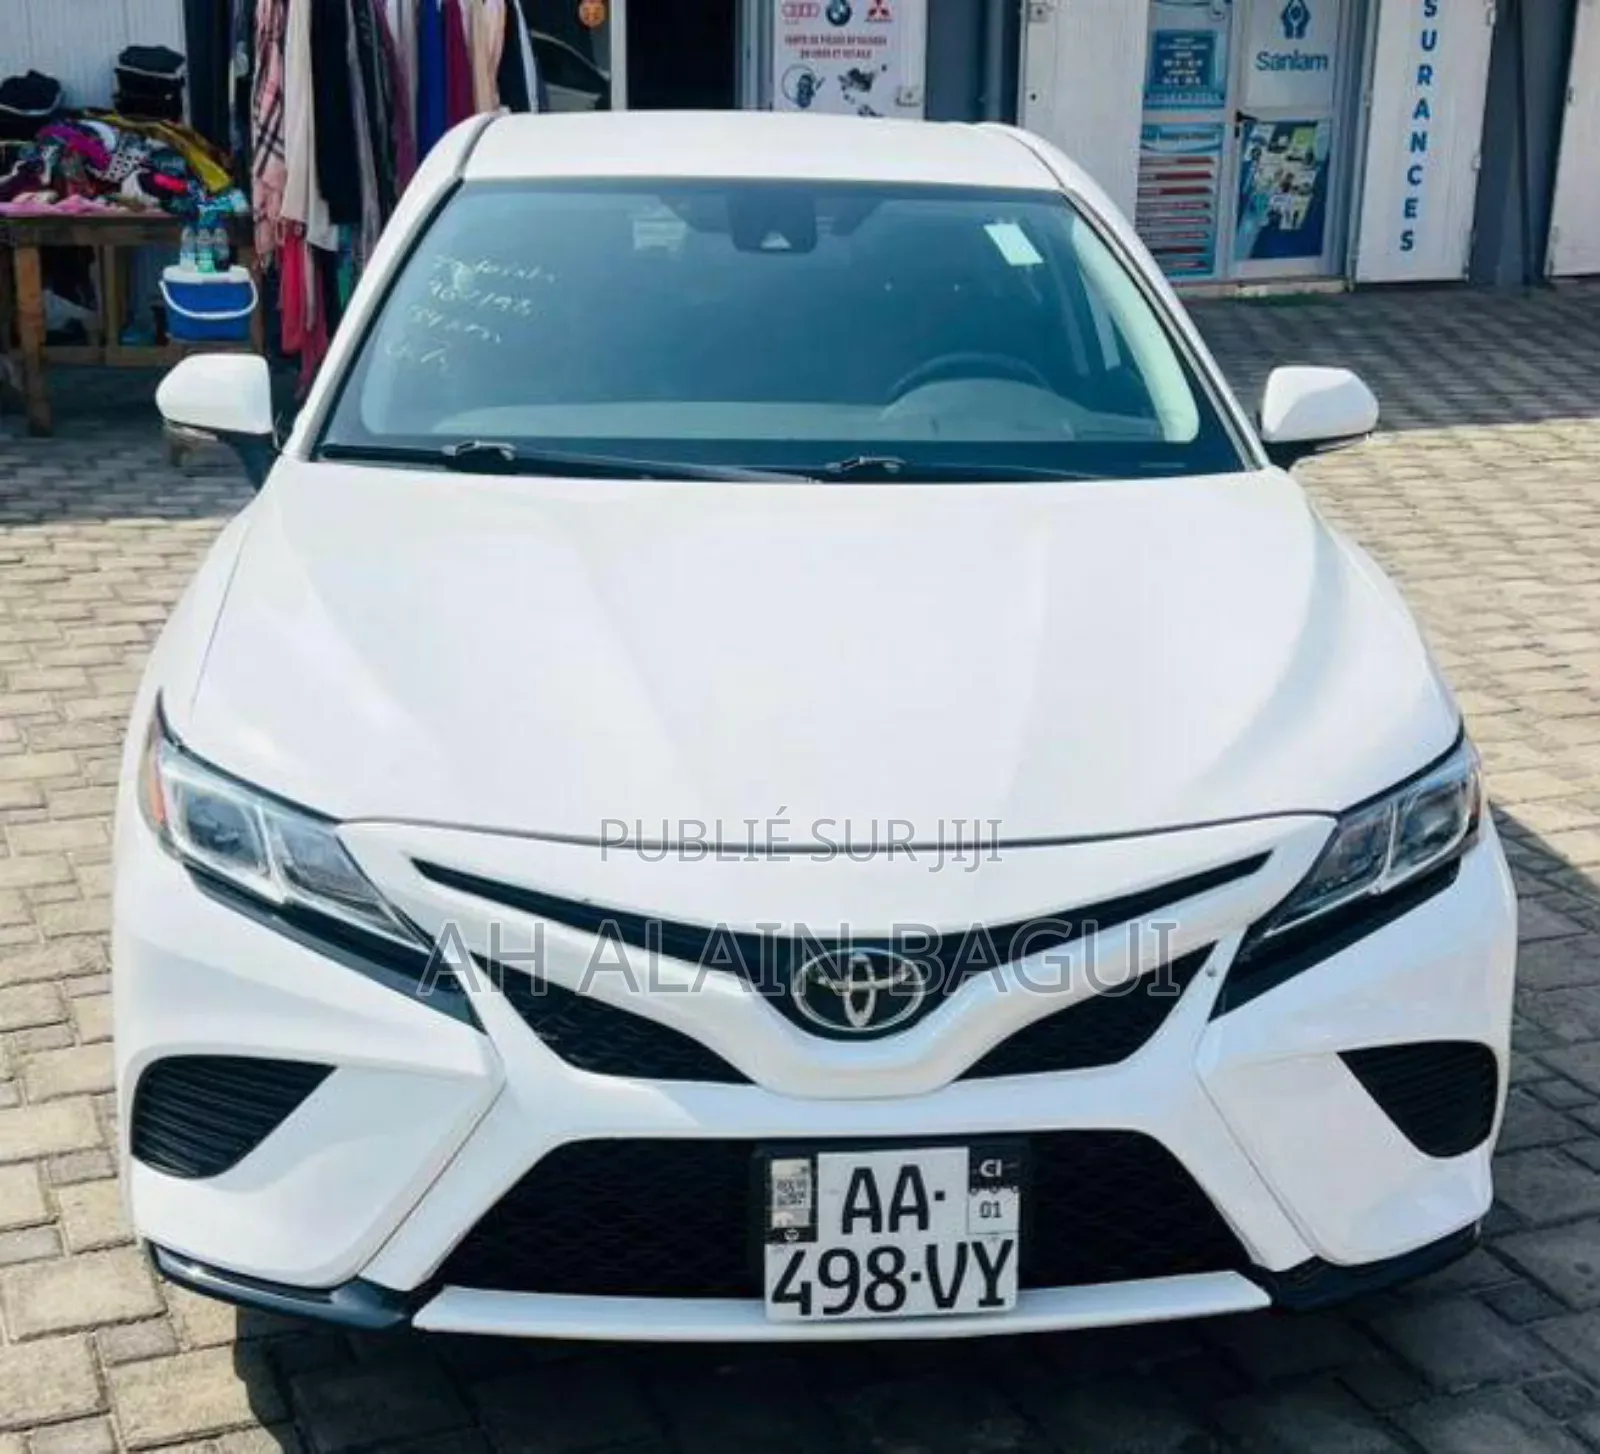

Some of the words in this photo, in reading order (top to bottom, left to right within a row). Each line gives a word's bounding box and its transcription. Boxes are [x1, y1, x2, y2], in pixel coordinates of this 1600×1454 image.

[1255, 48, 1329, 72] Sanlam
[979, 1159, 1002, 1178] CI
[979, 1200, 1003, 1219] 01
